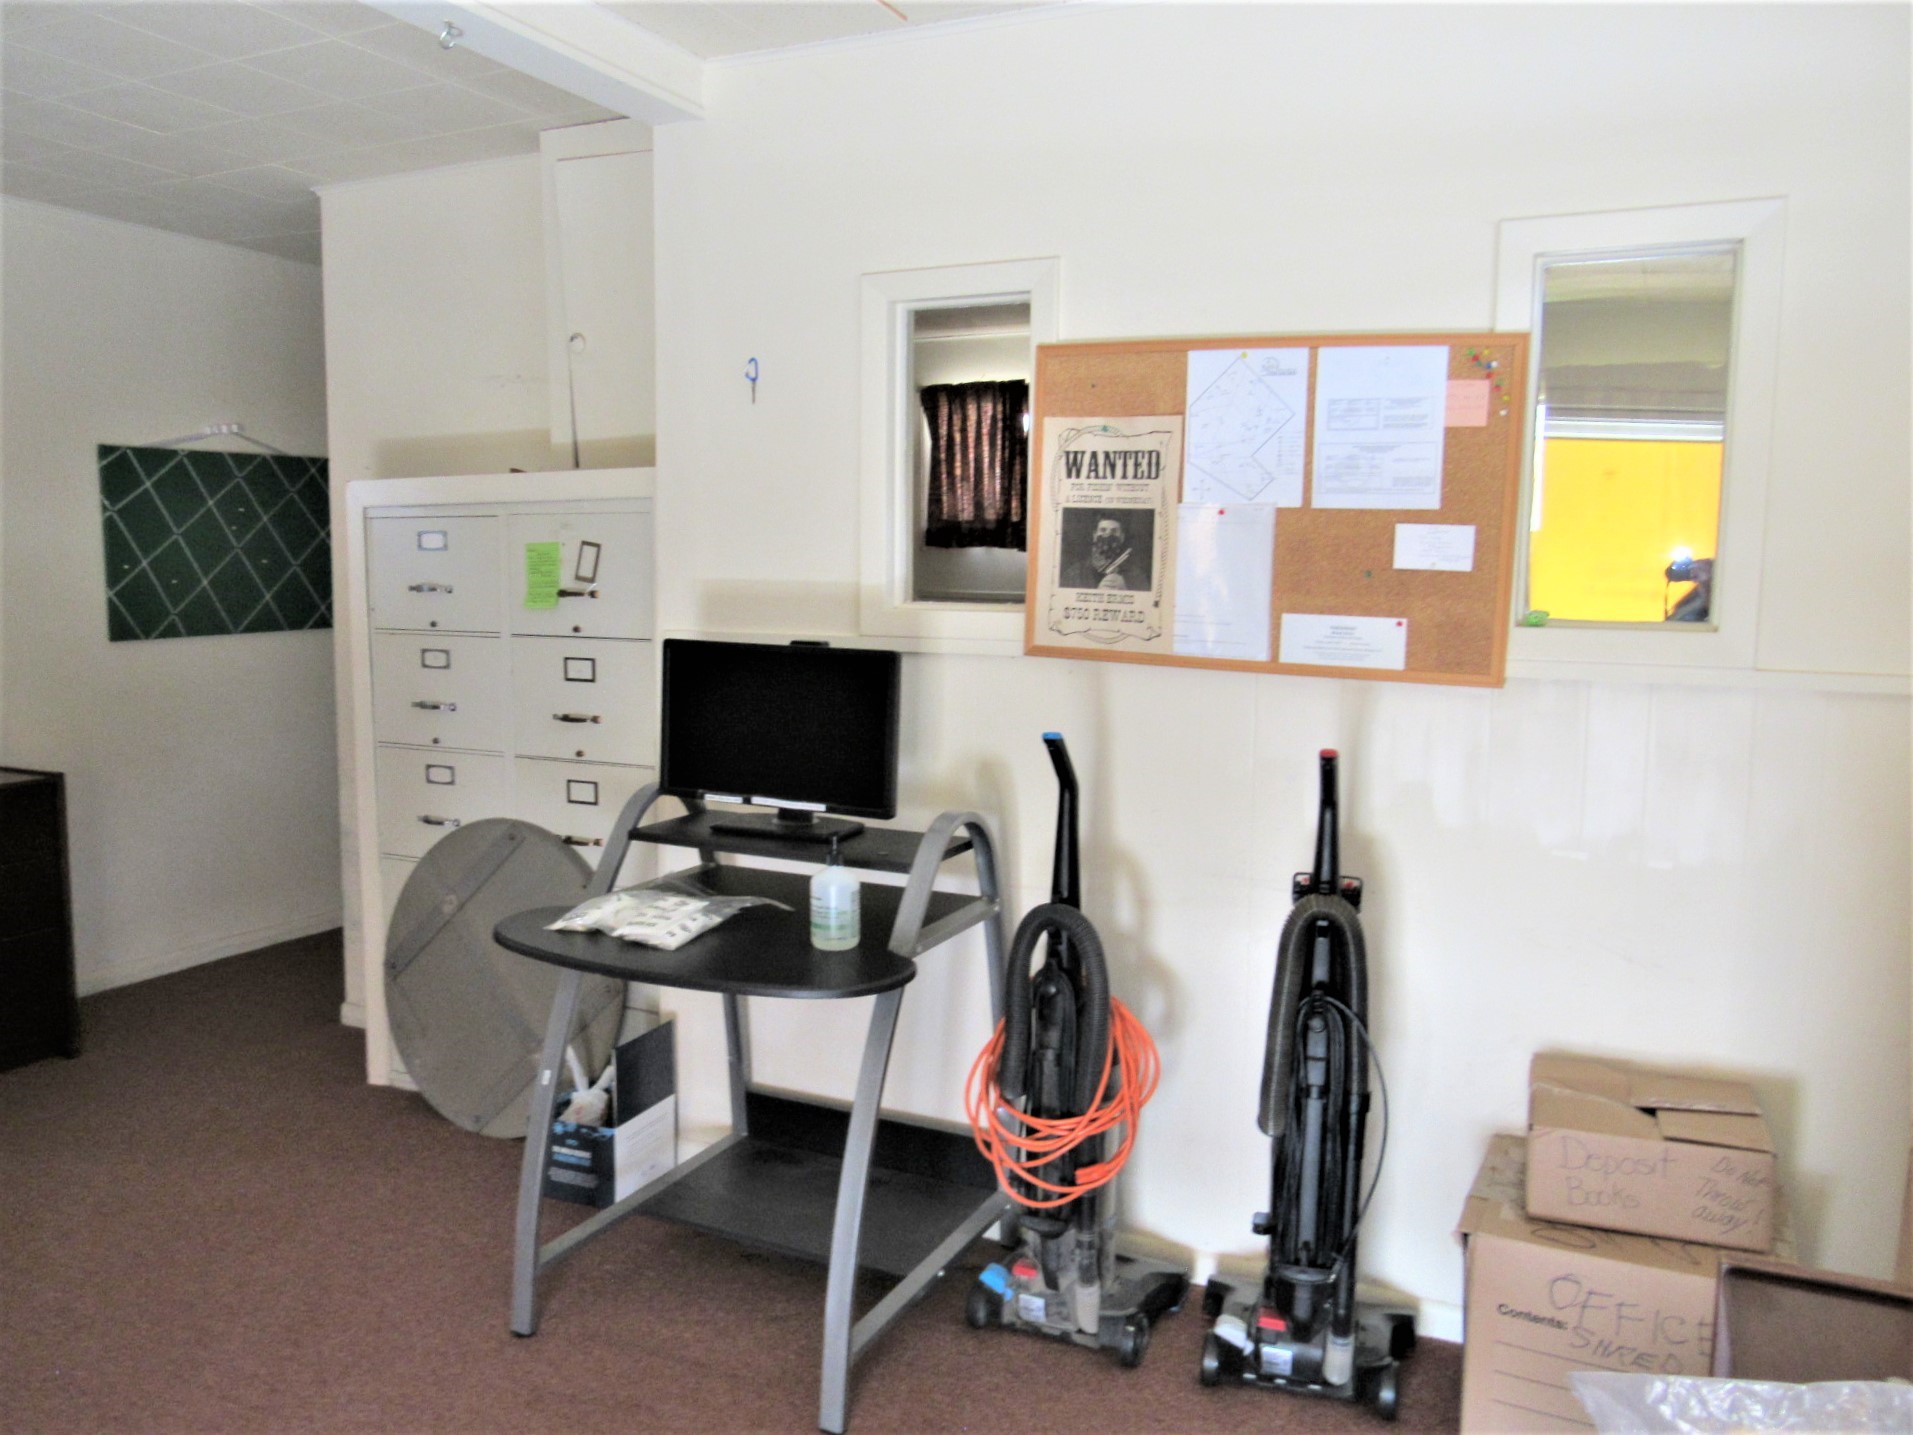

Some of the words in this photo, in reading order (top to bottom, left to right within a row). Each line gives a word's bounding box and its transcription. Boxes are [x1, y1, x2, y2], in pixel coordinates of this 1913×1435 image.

[1063, 450, 1160, 480] WANTED
[1093, 608, 1145, 623] REWARD
[1559, 1135, 1678, 1181] Deposit
[1565, 1176, 1641, 1209] Books
[1550, 1273, 1713, 1356] OFFICE
[1570, 1324, 1683, 1375] SHRED
